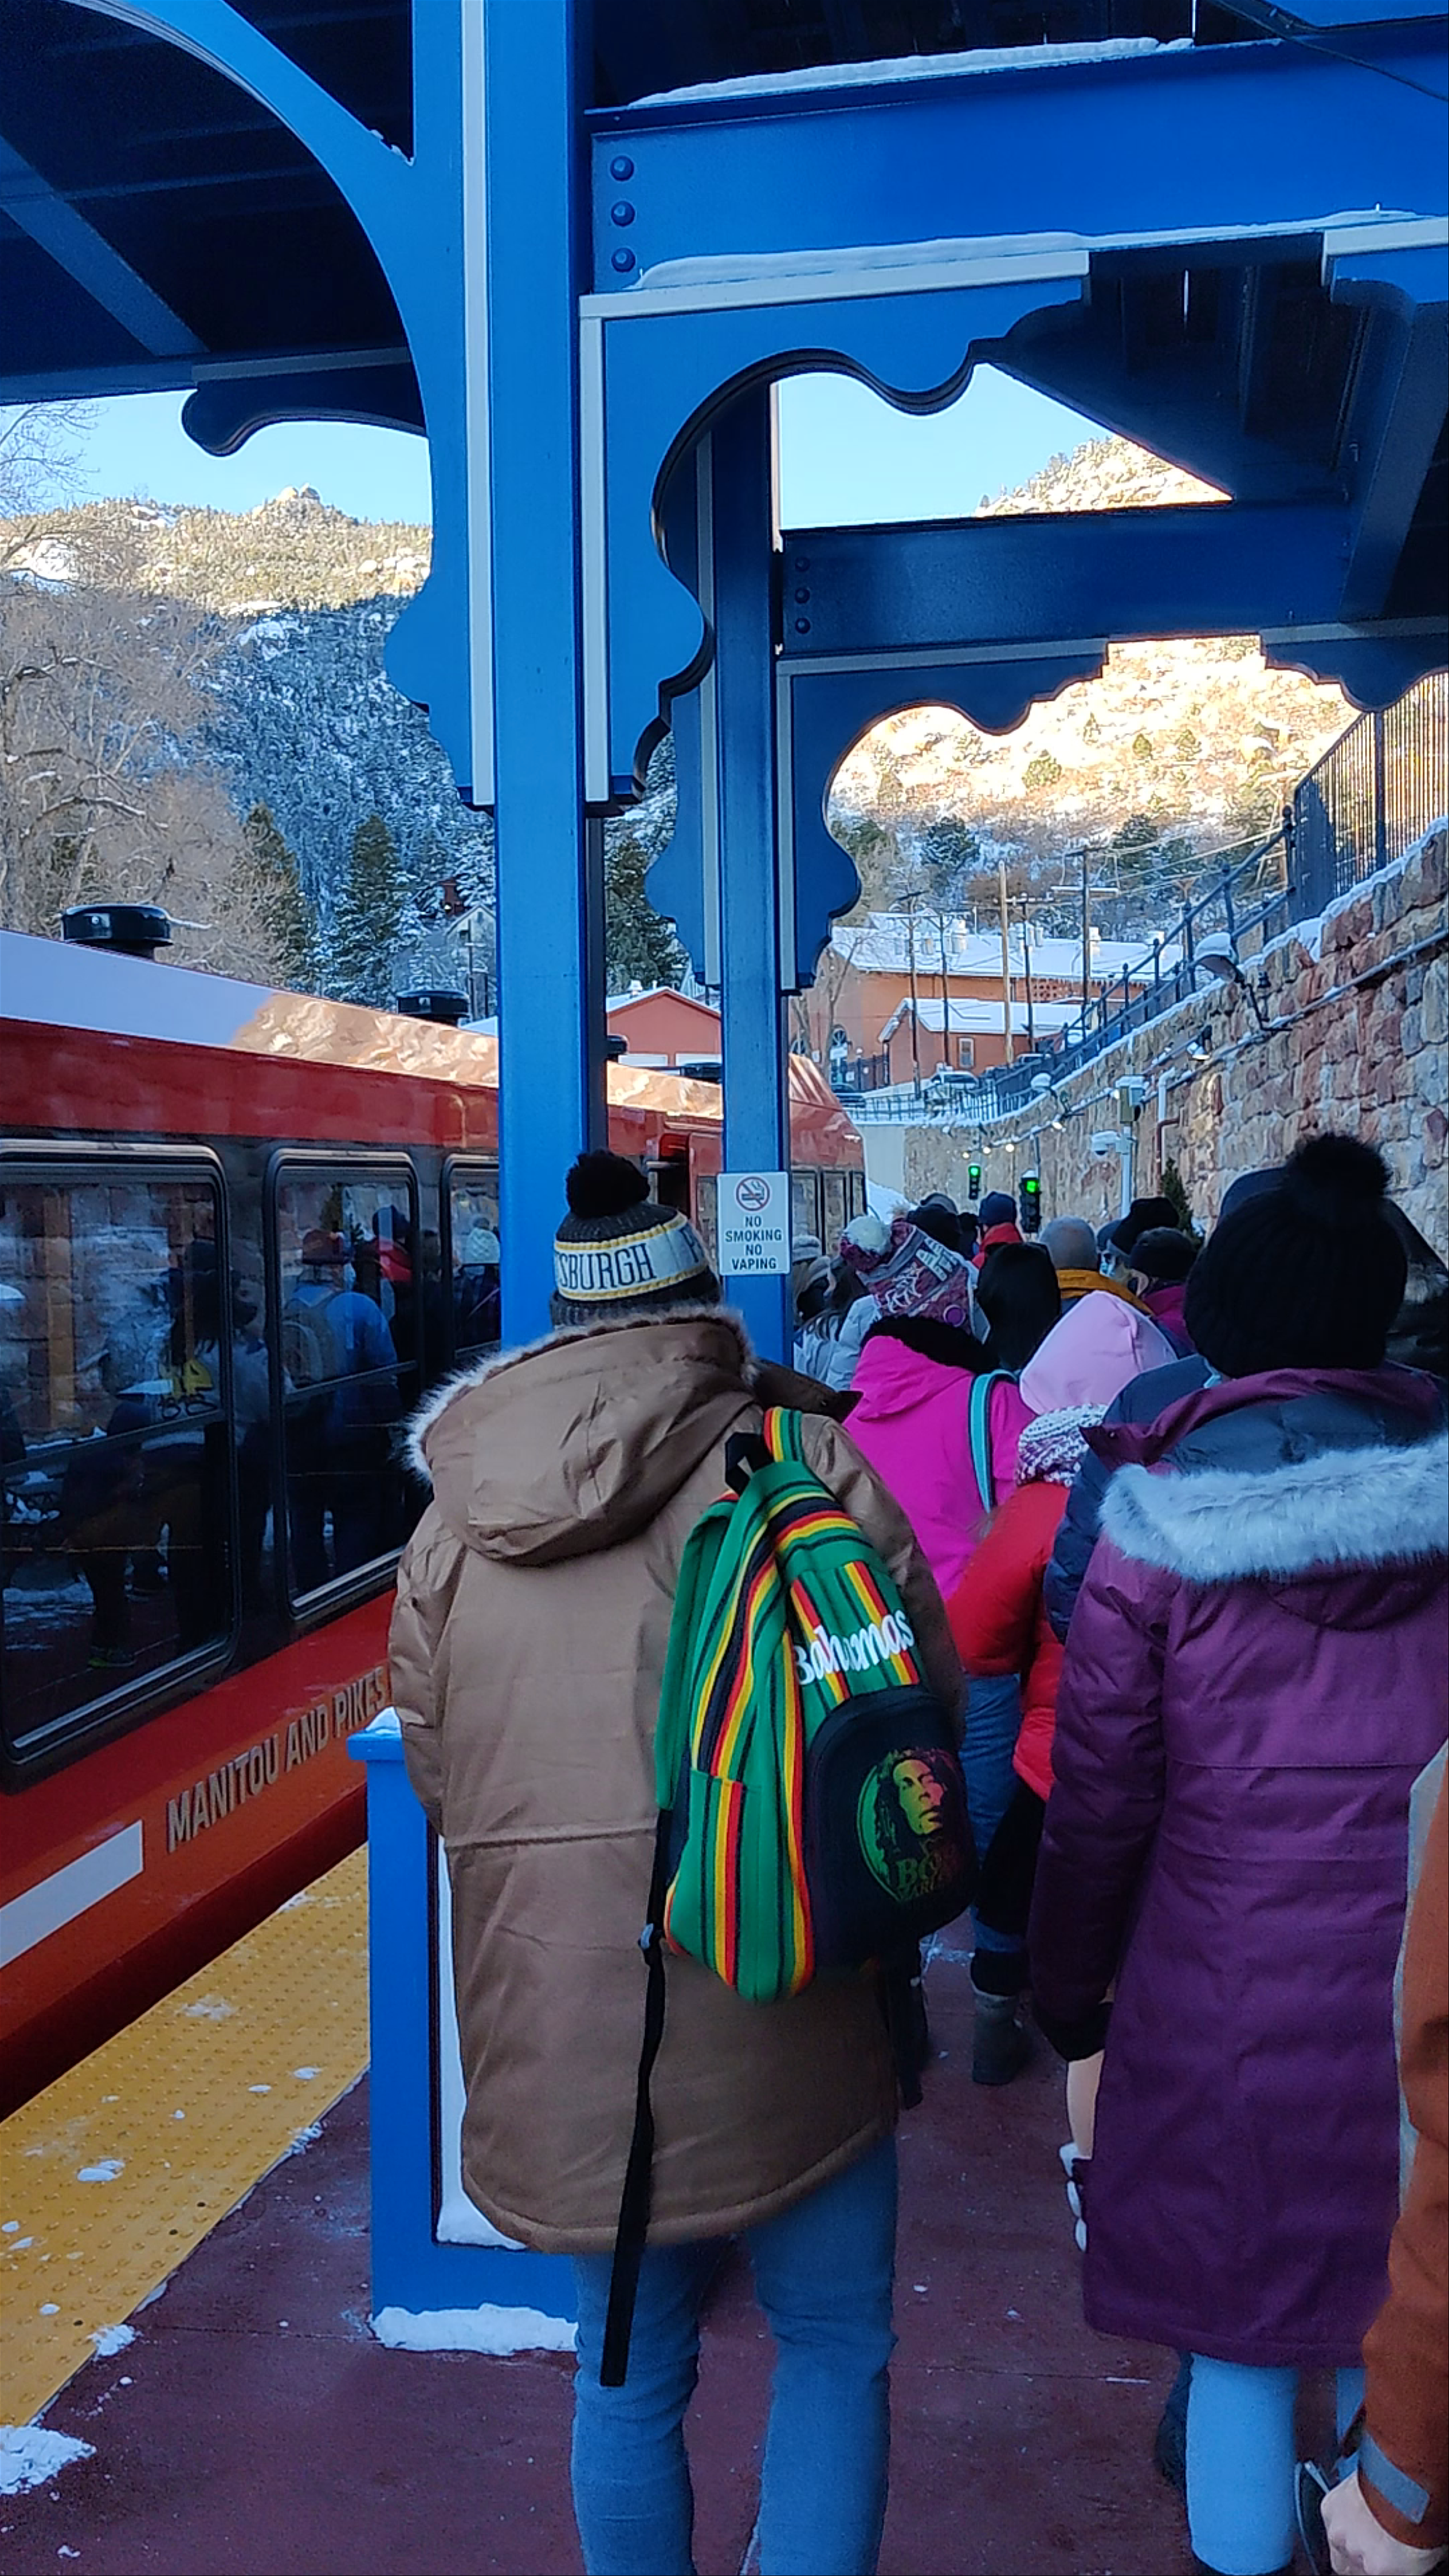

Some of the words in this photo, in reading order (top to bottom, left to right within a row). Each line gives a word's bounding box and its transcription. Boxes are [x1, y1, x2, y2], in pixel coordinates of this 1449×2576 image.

[745, 1216, 762, 1227] NO
[725, 1229, 782, 1242] SMOKING
[745, 1244, 762, 1256] NO
[554, 1243, 657, 1290] SBURGH
[732, 1257, 777, 1270] VAPING
[794, 1609, 915, 1684] Bahamas
[166, 1734, 278, 1853] MANITOU
[285, 1703, 329, 1773] AND
[334, 1666, 386, 1738] PIKES
